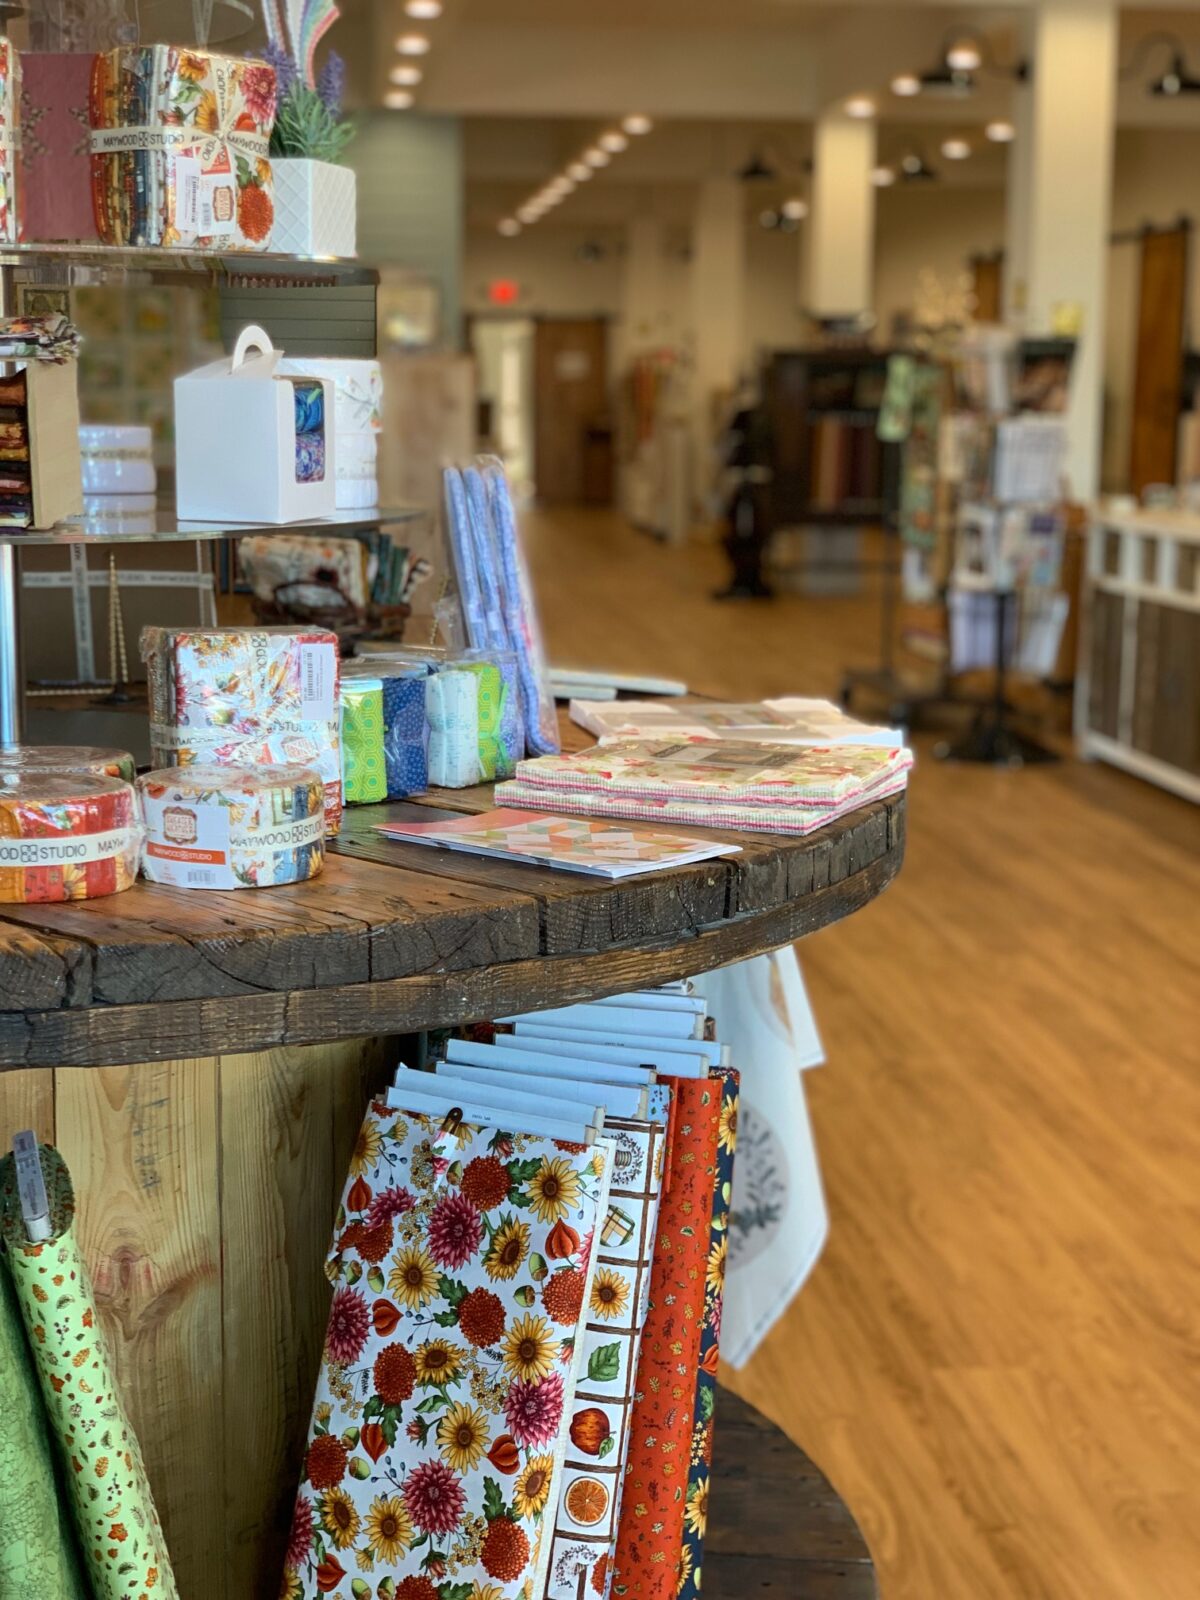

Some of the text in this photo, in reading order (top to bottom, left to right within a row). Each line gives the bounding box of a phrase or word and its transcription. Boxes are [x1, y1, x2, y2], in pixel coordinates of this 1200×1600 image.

[103, 134, 138, 146] MAYWOOD
[150, 133, 185, 145] STUDIO
[229, 829, 291, 848] MAYWOOD
[40, 844, 87, 859] STUDIO
